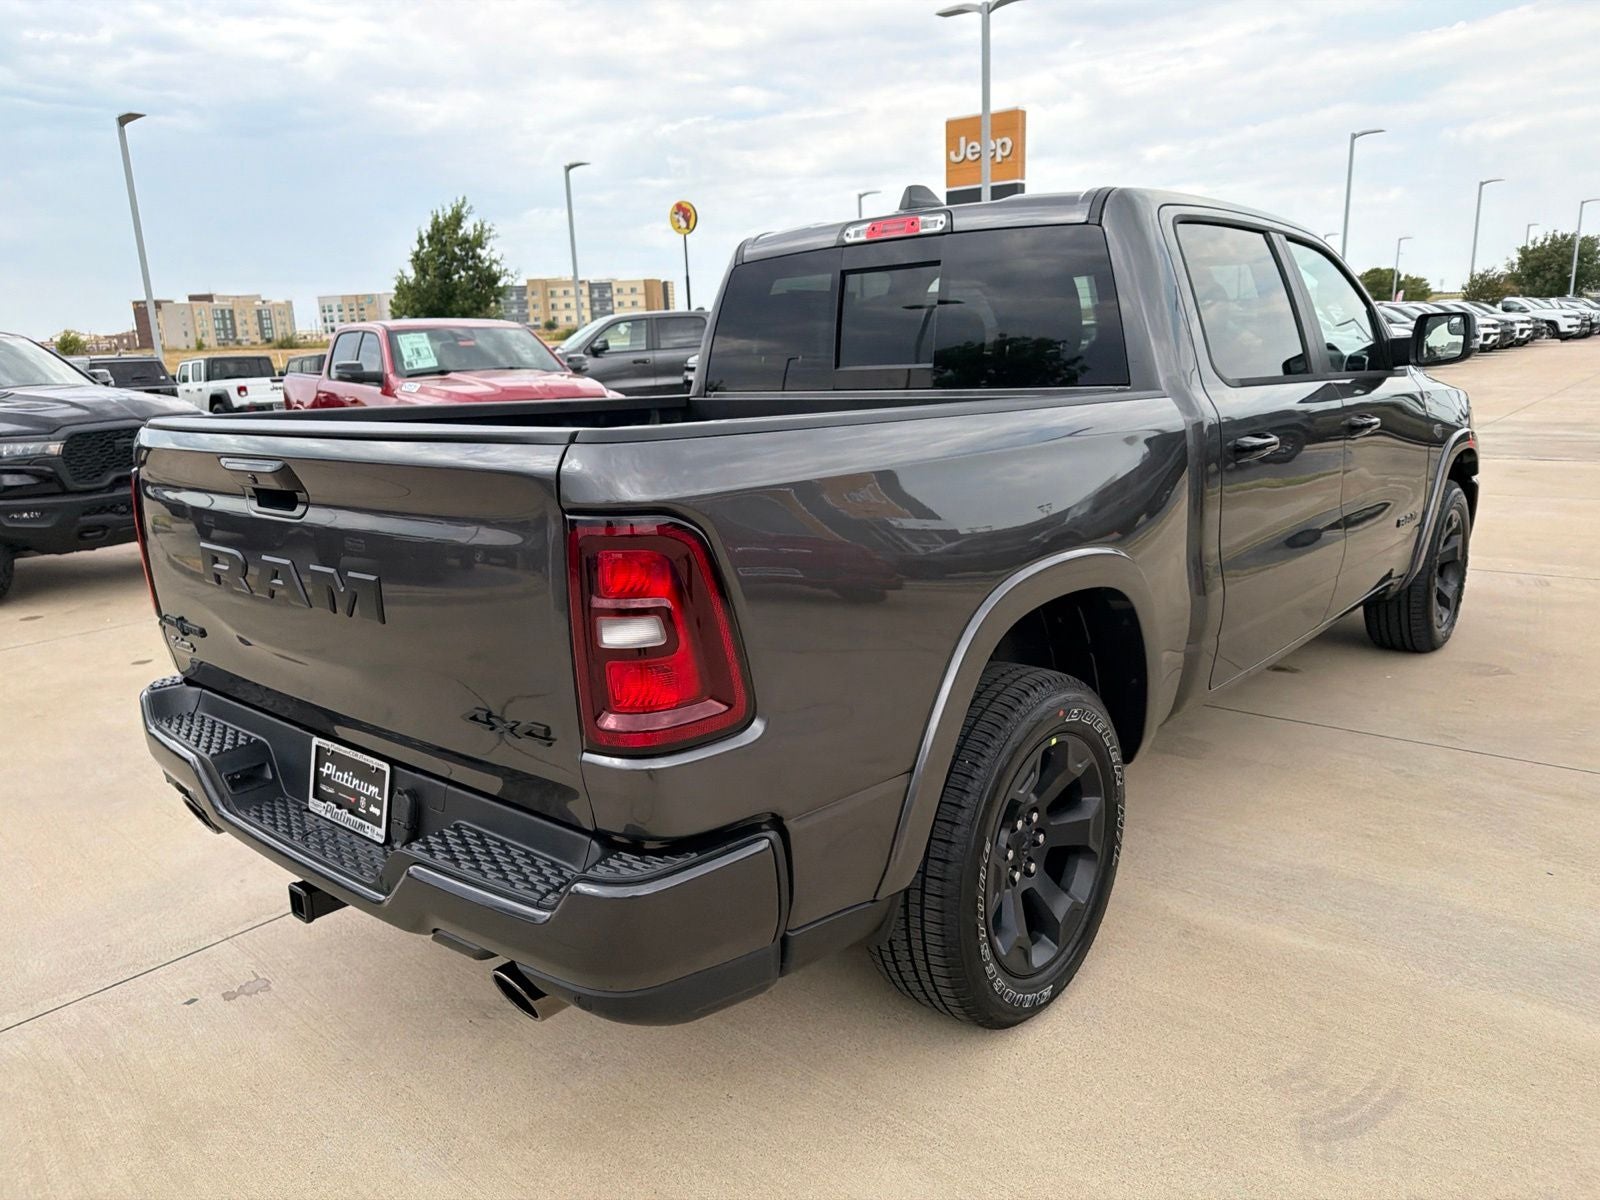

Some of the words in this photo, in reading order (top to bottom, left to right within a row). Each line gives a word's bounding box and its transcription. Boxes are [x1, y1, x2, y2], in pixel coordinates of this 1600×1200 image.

[200, 541, 386, 625] RAM
[1065, 708, 1124, 786] DUELER
[319, 761, 382, 800] Platinum
[324, 803, 369, 833] Platinum
